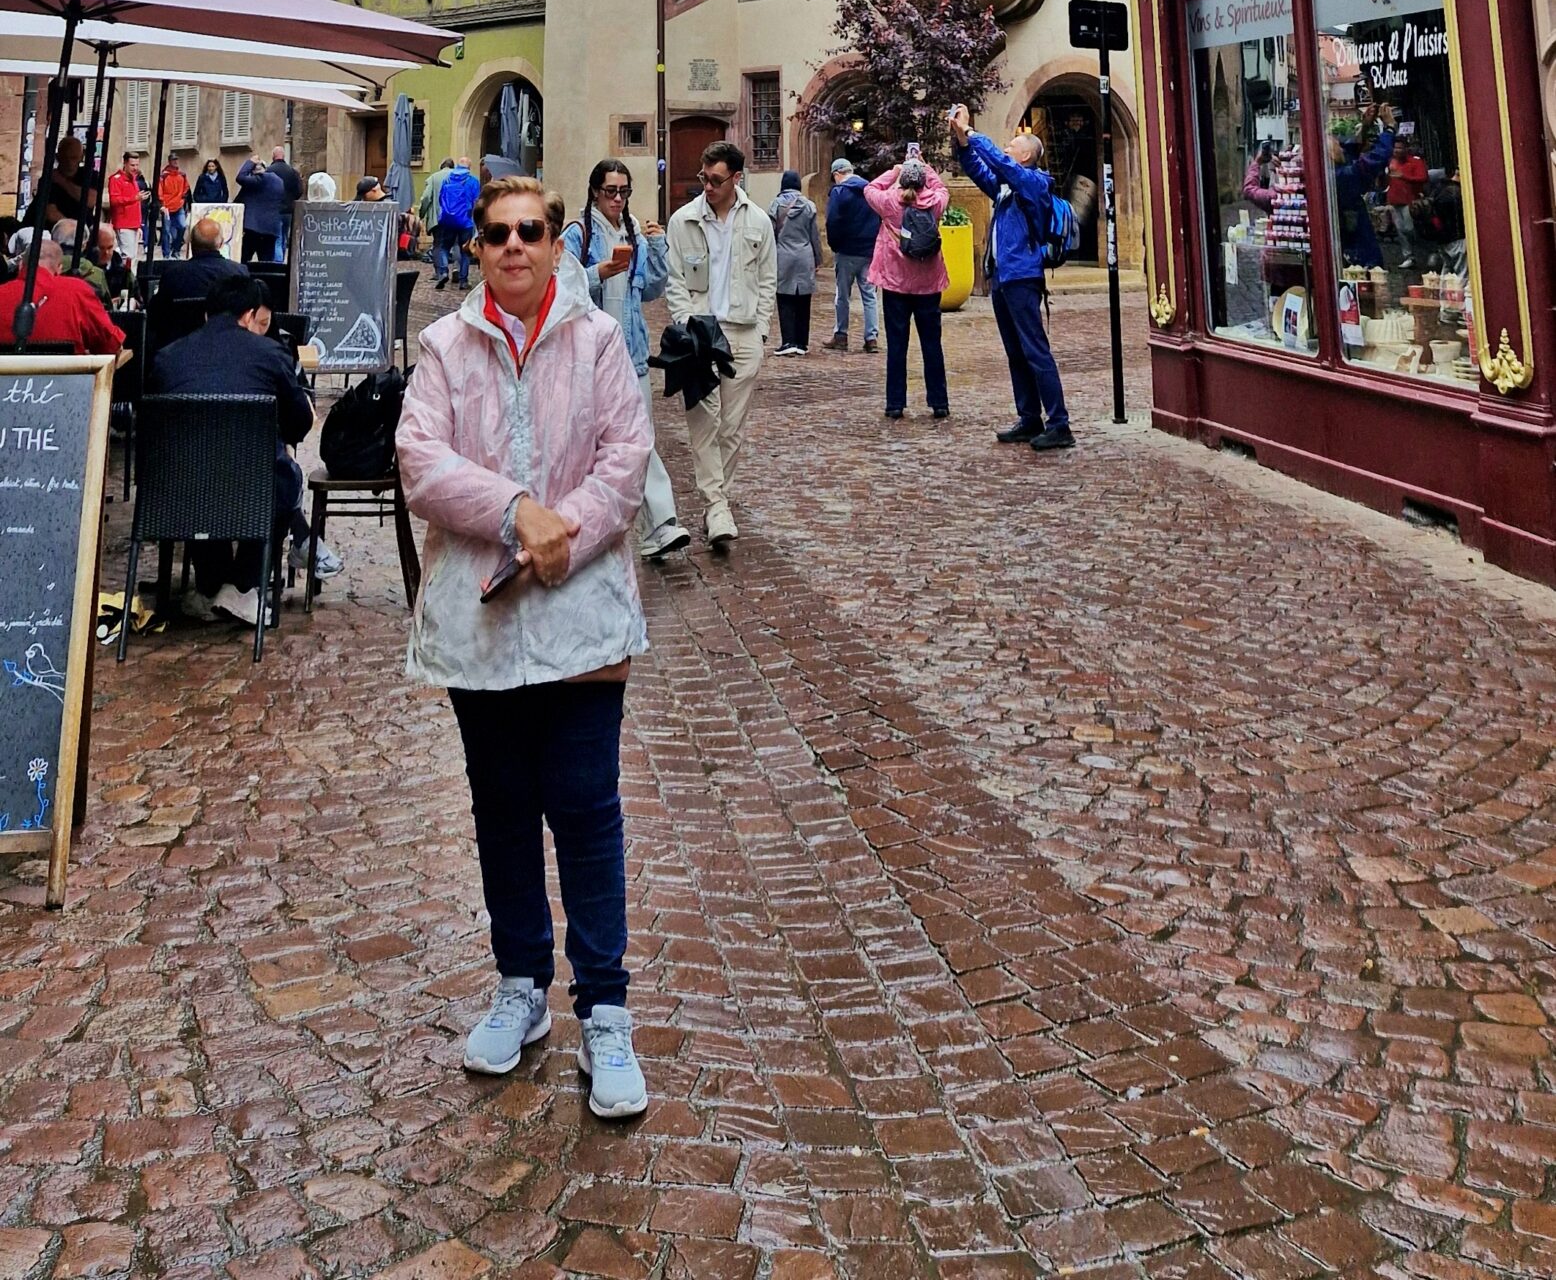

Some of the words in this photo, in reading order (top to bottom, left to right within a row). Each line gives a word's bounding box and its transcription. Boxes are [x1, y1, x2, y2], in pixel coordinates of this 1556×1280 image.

[1189, 8, 1211, 34] Vins
[1214, 6, 1224, 30] &
[1332, 37, 1384, 67] Douceurs
[1388, 30, 1399, 61] &
[1402, 22, 1448, 63] Plaisirs
[3, 378, 63, 404] thé
[12, 423, 60, 451] THÉ
